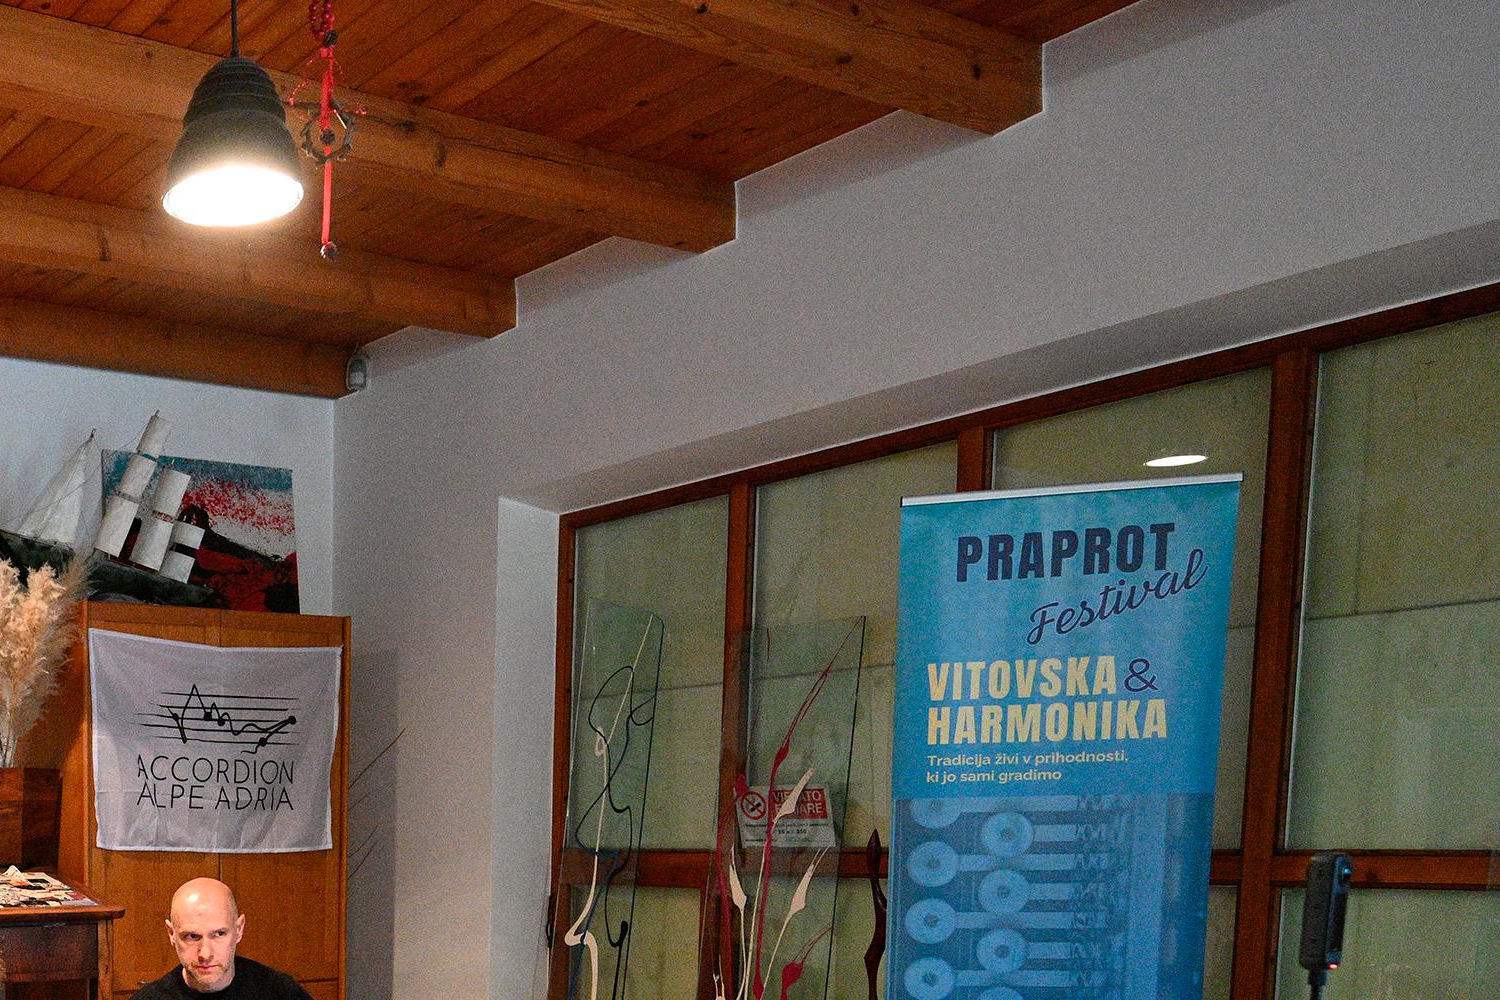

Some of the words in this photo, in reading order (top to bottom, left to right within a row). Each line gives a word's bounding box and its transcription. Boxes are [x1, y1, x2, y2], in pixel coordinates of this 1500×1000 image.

[956, 522, 1175, 582] PRAPROT
[1026, 549, 1208, 645] Festival
[927, 655, 1117, 701] VITOVSKA
[1124, 658, 1158, 692] &
[927, 699, 1167, 745] HARMONIKA
[137, 754, 295, 784] ACCORDION
[927, 754, 991, 770] Tradicija
[995, 752, 1020, 766] živi
[1023, 756, 1031, 765] v
[926, 771, 939, 783] ki
[941, 772, 956, 785] jo
[960, 770, 995, 783] sami
[998, 769, 1062, 785] gradimo
[137, 781, 205, 810] ALPE
[215, 786, 294, 811] ADRIA
[772, 790, 821, 802] VIEATO
[774, 802, 823, 815] FARE
